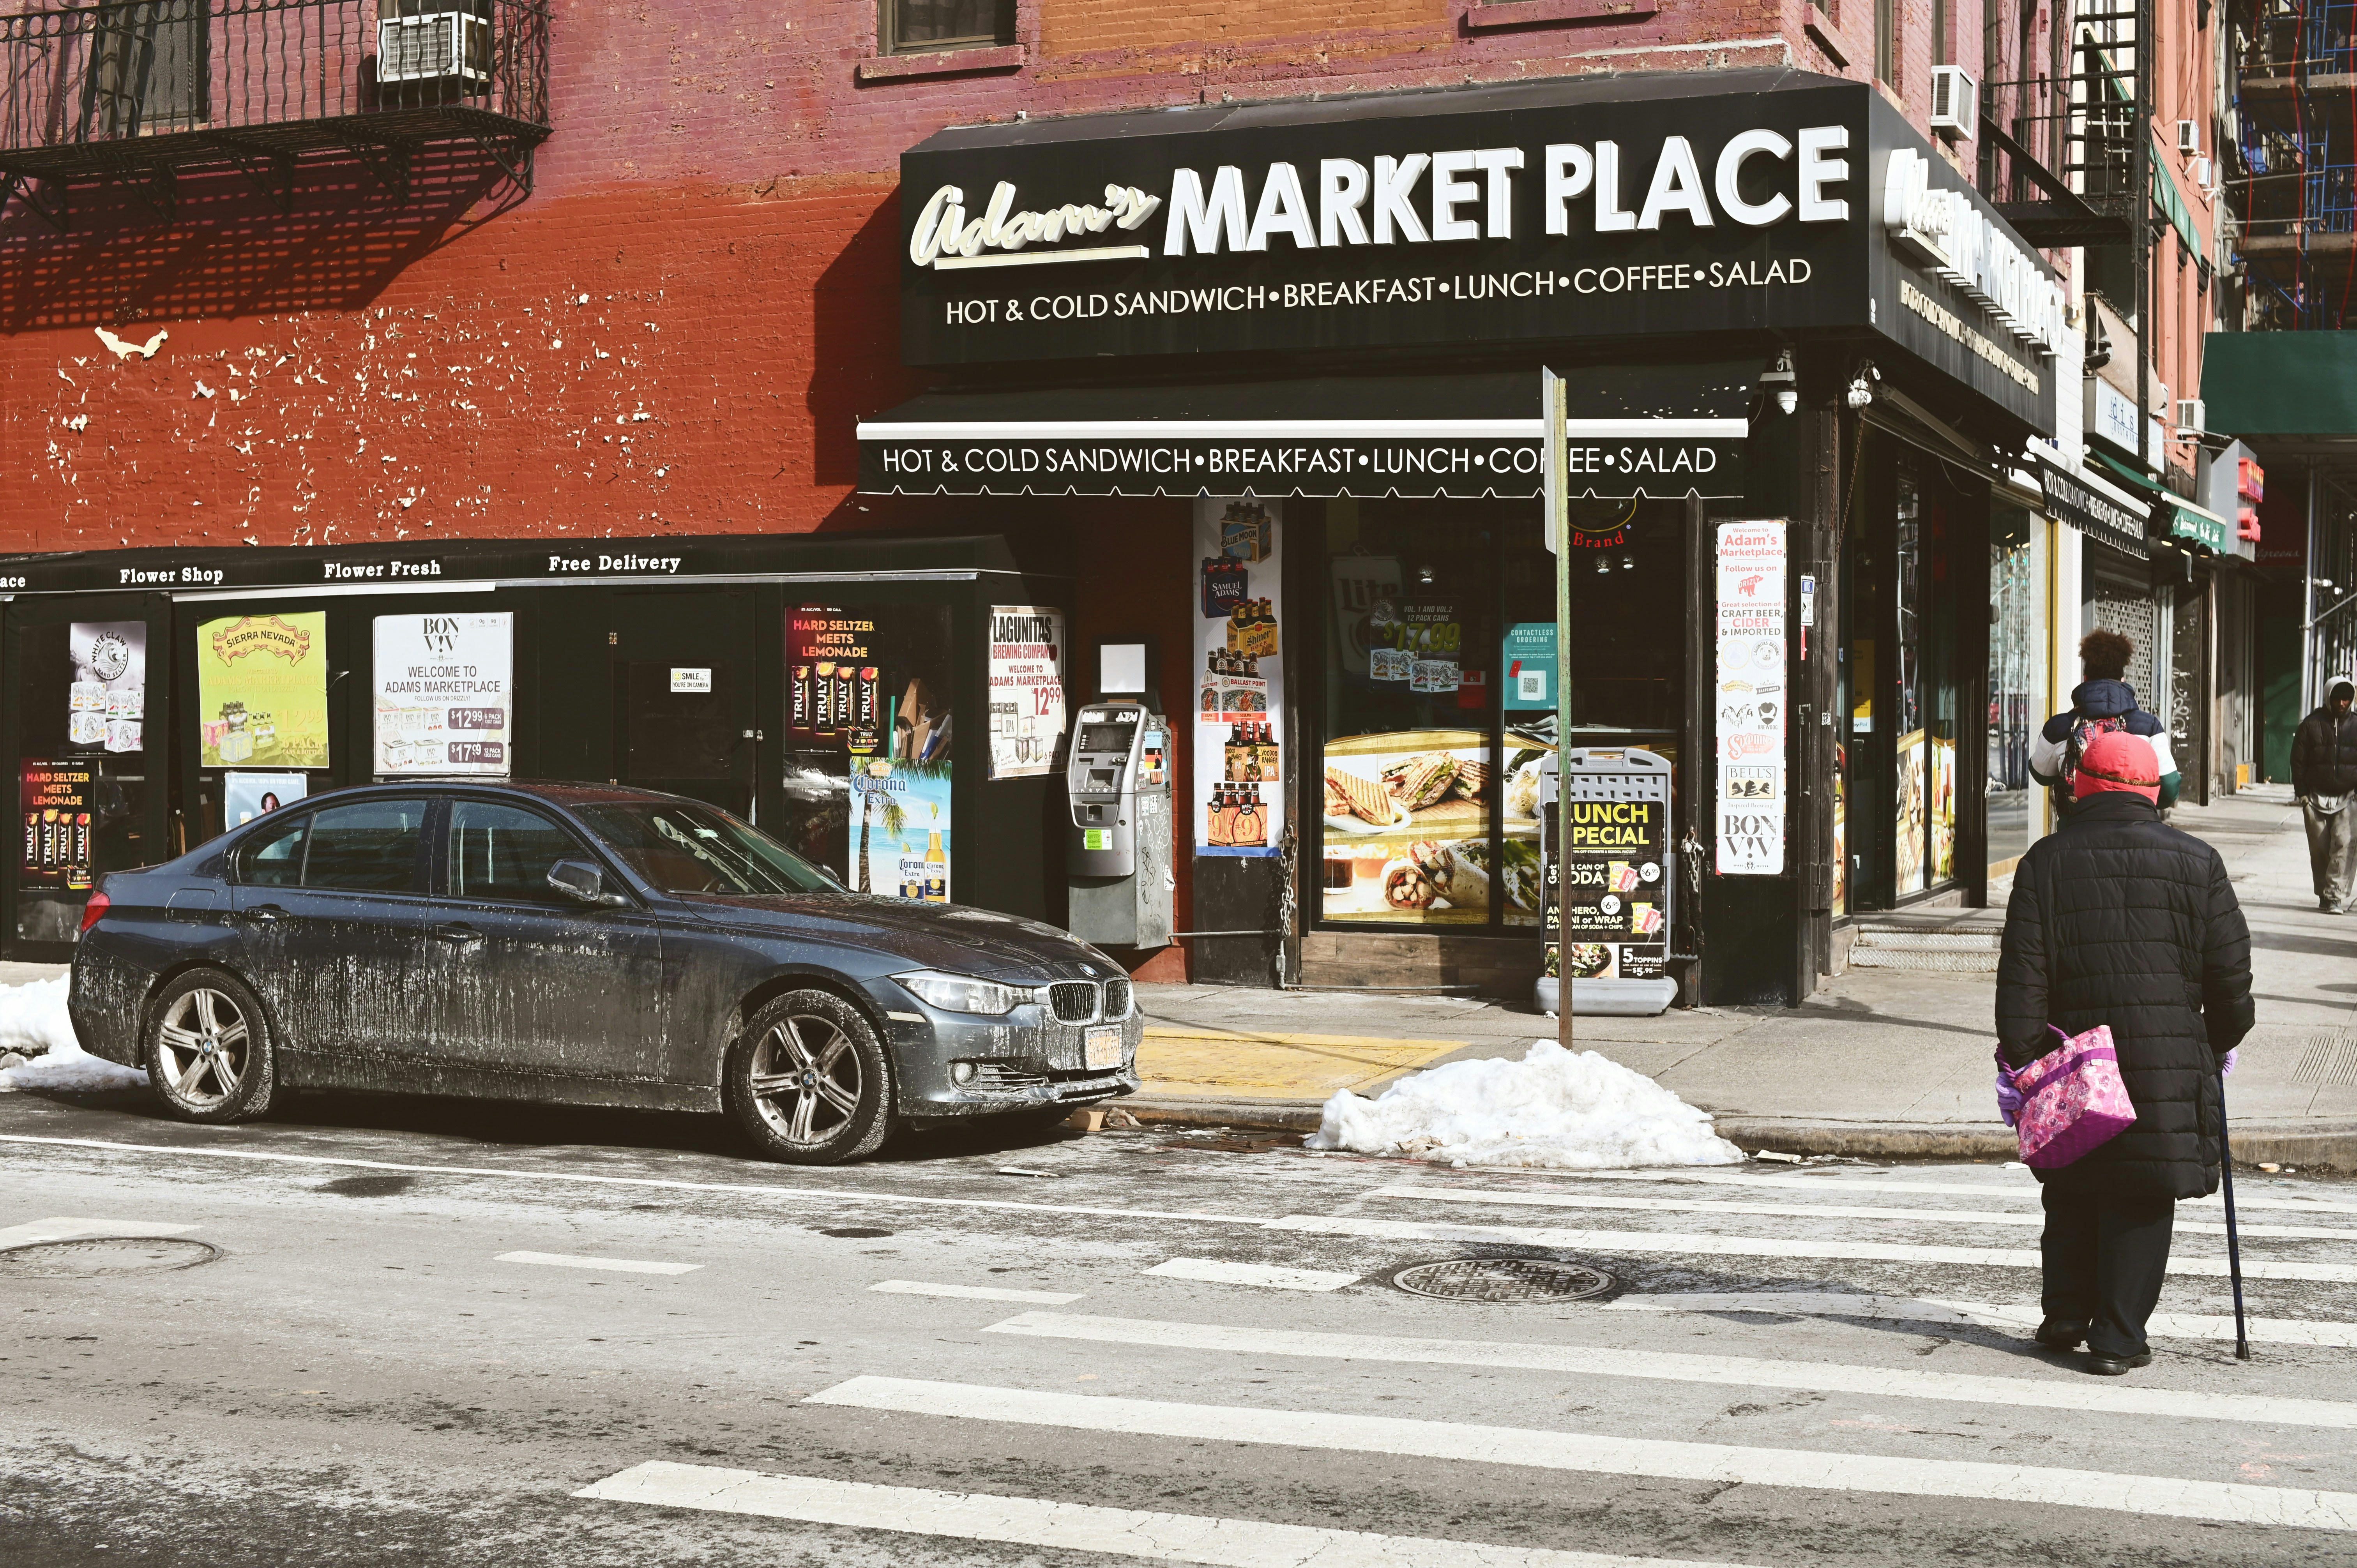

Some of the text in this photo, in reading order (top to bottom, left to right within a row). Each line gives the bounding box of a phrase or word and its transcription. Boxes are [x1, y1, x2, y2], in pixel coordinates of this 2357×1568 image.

[910, 125, 1849, 267] Adam's MARKET PLACE
[947, 258, 1811, 324] HOT & COLD SANDWICH BREAKFAST LUNCH COFFEE SALAD
[884, 448, 1716, 473] HOT & COLD SANDWICH BREAKFAST LUNCH COEE SALAD
[2044, 468, 2054, 494] HOT
[2058, 476, 2069, 503] COLD
[2069, 483, 2089, 514] SANDWICH
[2090, 495, 2108, 524] BREAKFAST
[2109, 506, 2120, 529] LUNCH
[2121, 512, 2133, 536] COFFEE
[2133, 518, 2143, 540] SALAD
[1221, 530, 1257, 548] BLUE MOON
[1573, 530, 1624, 547] Brand
[1724, 533, 1777, 546] Adam's
[1720, 548, 1782, 558] Marketplace
[324, 560, 441, 578] Flower Fresh
[549, 554, 681, 573] Free Delivery
[120, 567, 223, 584] Flower Shop
[1739, 576, 1760, 588] DRIZLY
[1212, 581, 1242, 591] SAMUEL
[1215, 589, 1239, 598] ADAMS
[1756, 609, 1783, 618] BEER,
[423, 618, 459, 634] BON
[793, 620, 827, 630] HARD
[1732, 618, 1769, 627] CIDER
[993, 616, 1052, 643] LAGUNITAS
[226, 630, 296, 648] SIERRA NEVADA
[816, 633, 854, 644] MEETS
[1246, 630, 1271, 647] Shiner
[1384, 621, 1461, 652] $17.99
[92, 631, 126, 663] WHITE CLAW
[802, 646, 868, 657] LEMONADE
[993, 644, 1022, 659] BREWING
[1250, 640, 1268, 651] BOCK
[97, 653, 126, 678] HARD SELTZER
[408, 666, 477, 678] WELCOME TO
[1009, 665, 1034, 673] WELCOME
[208, 675, 318, 686] ADAMS MARKETPLACE
[385, 681, 500, 693] ADAMS MARKETPLACE
[989, 675, 1061, 687] ADAMS MARKETPLACE
[794, 680, 802, 720] TRULY
[817, 678, 827, 724] TRULY
[838, 680, 847, 720] TRULY
[862, 681, 870, 722] TRULY
[1006, 720, 1014, 732] IPA
[27, 773, 89, 782] HARD SELTZER
[1264, 766, 1275, 777] IPA
[1730, 768, 1772, 778] BELL'S
[44, 784, 72, 793] MEETS
[853, 773, 907, 795] Corona
[33, 796, 82, 805] LEMONADE
[868, 793, 896, 805] Extra
[1571, 804, 1648, 823] UNCH
[1724, 815, 1777, 835] BON
[1573, 826, 1650, 845] PECIAL
[1548, 864, 1557, 884] Get
[1571, 871, 1605, 884] ODA
[1571, 906, 1599, 915] HERO,
[1602, 901, 1619, 909] $6.95
[1594, 916, 1623, 924] WRAP
[1622, 948, 1633, 962] 5
[1633, 968, 1653, 976] $5.95
